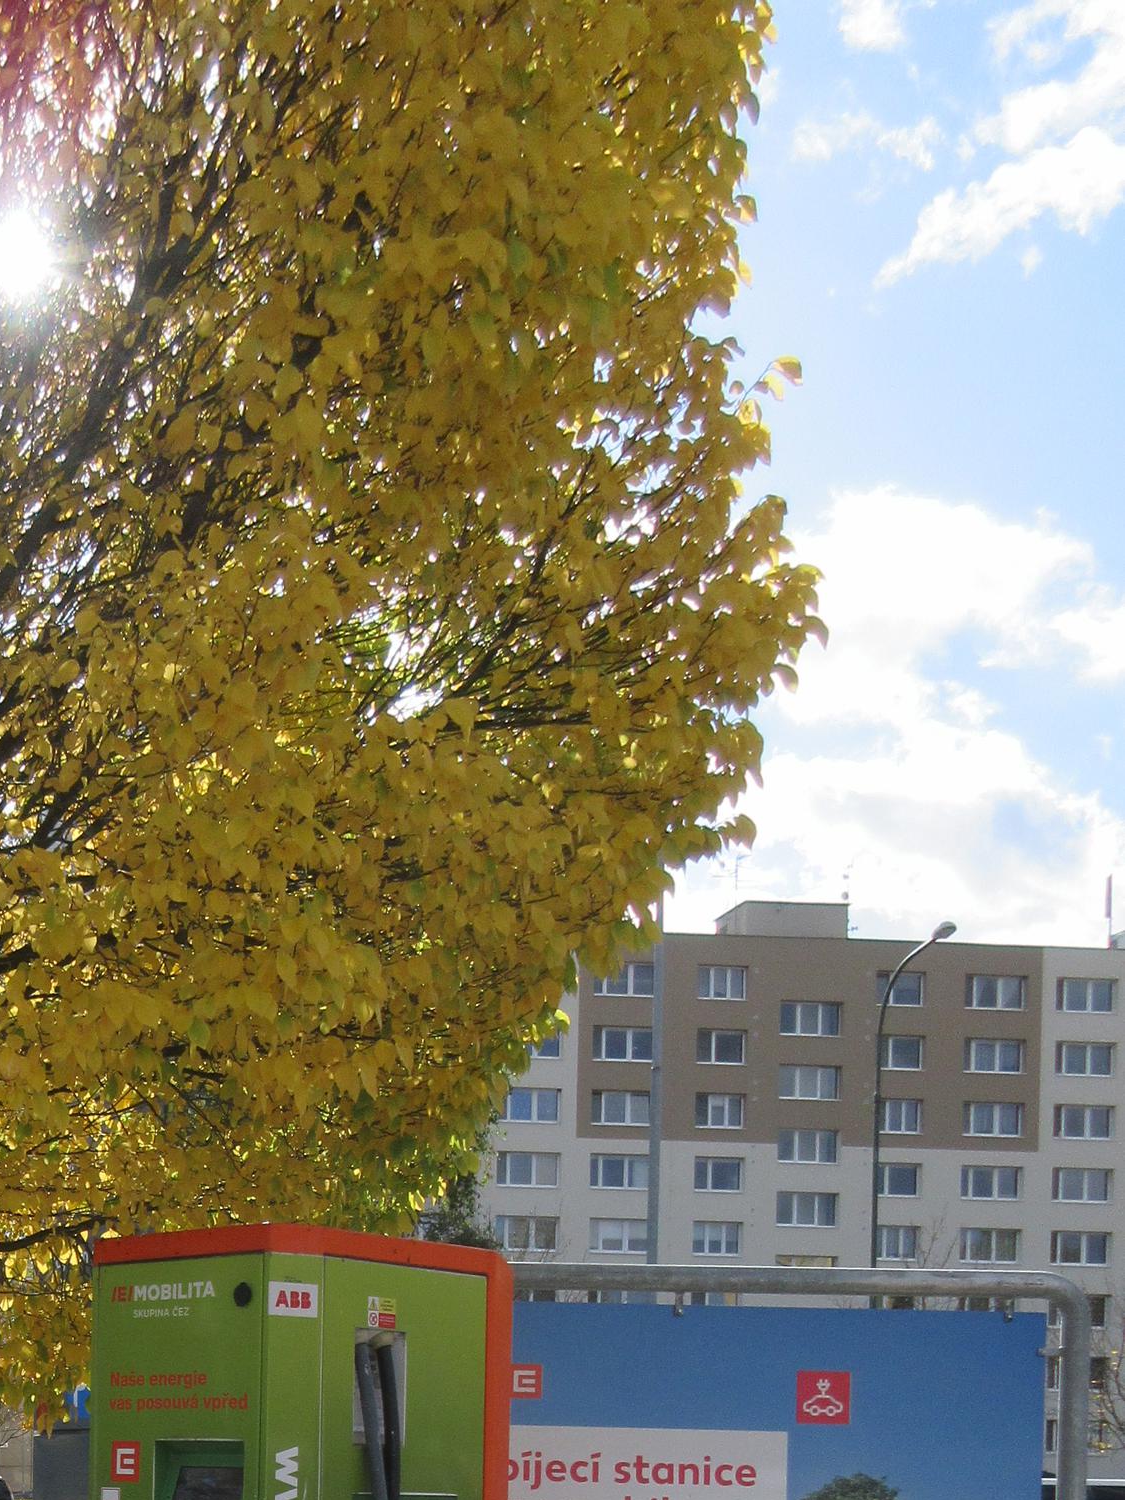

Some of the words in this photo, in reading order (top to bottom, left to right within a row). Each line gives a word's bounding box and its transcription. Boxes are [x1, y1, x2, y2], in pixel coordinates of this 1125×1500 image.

[276, 1290, 312, 1309] ABB
[133, 1308, 170, 1318] SKUPINA
[149, 1370, 208, 1389] energie
[614, 1455, 757, 1487] stanice
